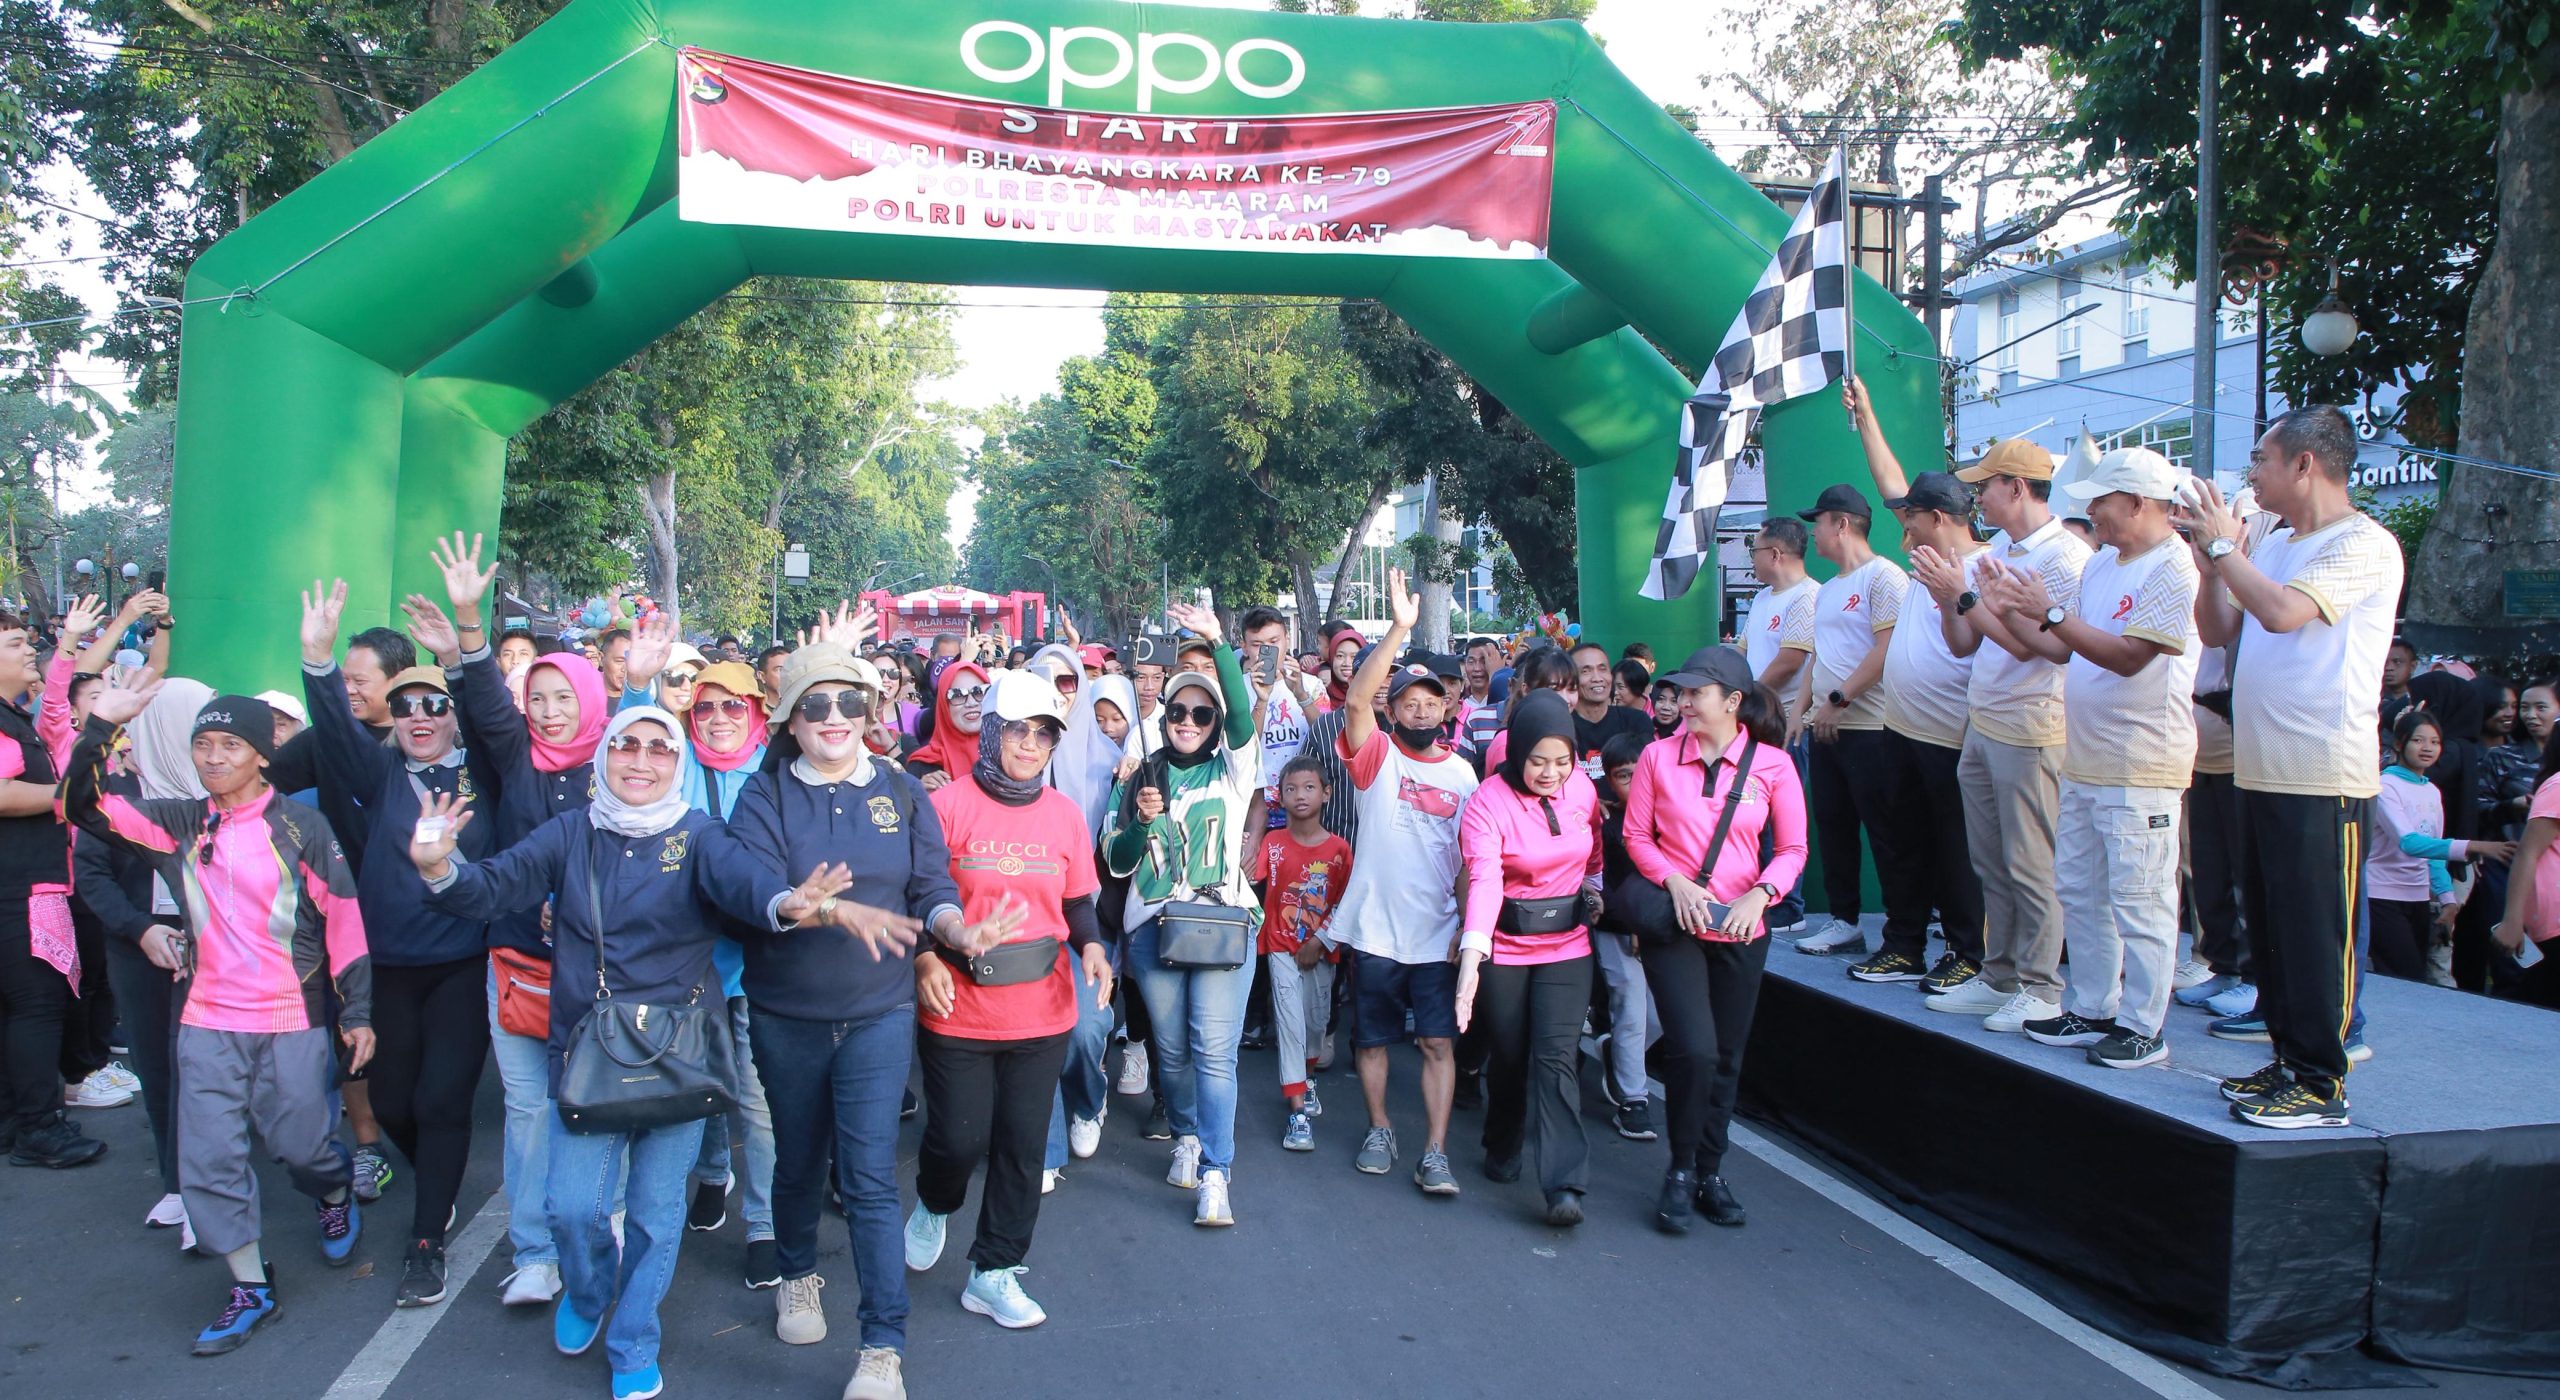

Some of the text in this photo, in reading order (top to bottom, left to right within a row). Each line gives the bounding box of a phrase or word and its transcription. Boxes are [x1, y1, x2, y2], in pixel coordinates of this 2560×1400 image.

[959, 20, 1305, 112] oppo
[1000, 108, 1250, 145] START
[850, 138, 1392, 187] HARI BHAYANGKARA KE-79
[917, 174, 1329, 214] POLRESTA MATARAM
[848, 197, 1388, 243] POLRI UNTUK MASYARAKAT
[914, 617, 943, 629] JALAN
[1265, 727, 1300, 745] RUN
[970, 840, 1047, 858] GUCCI
